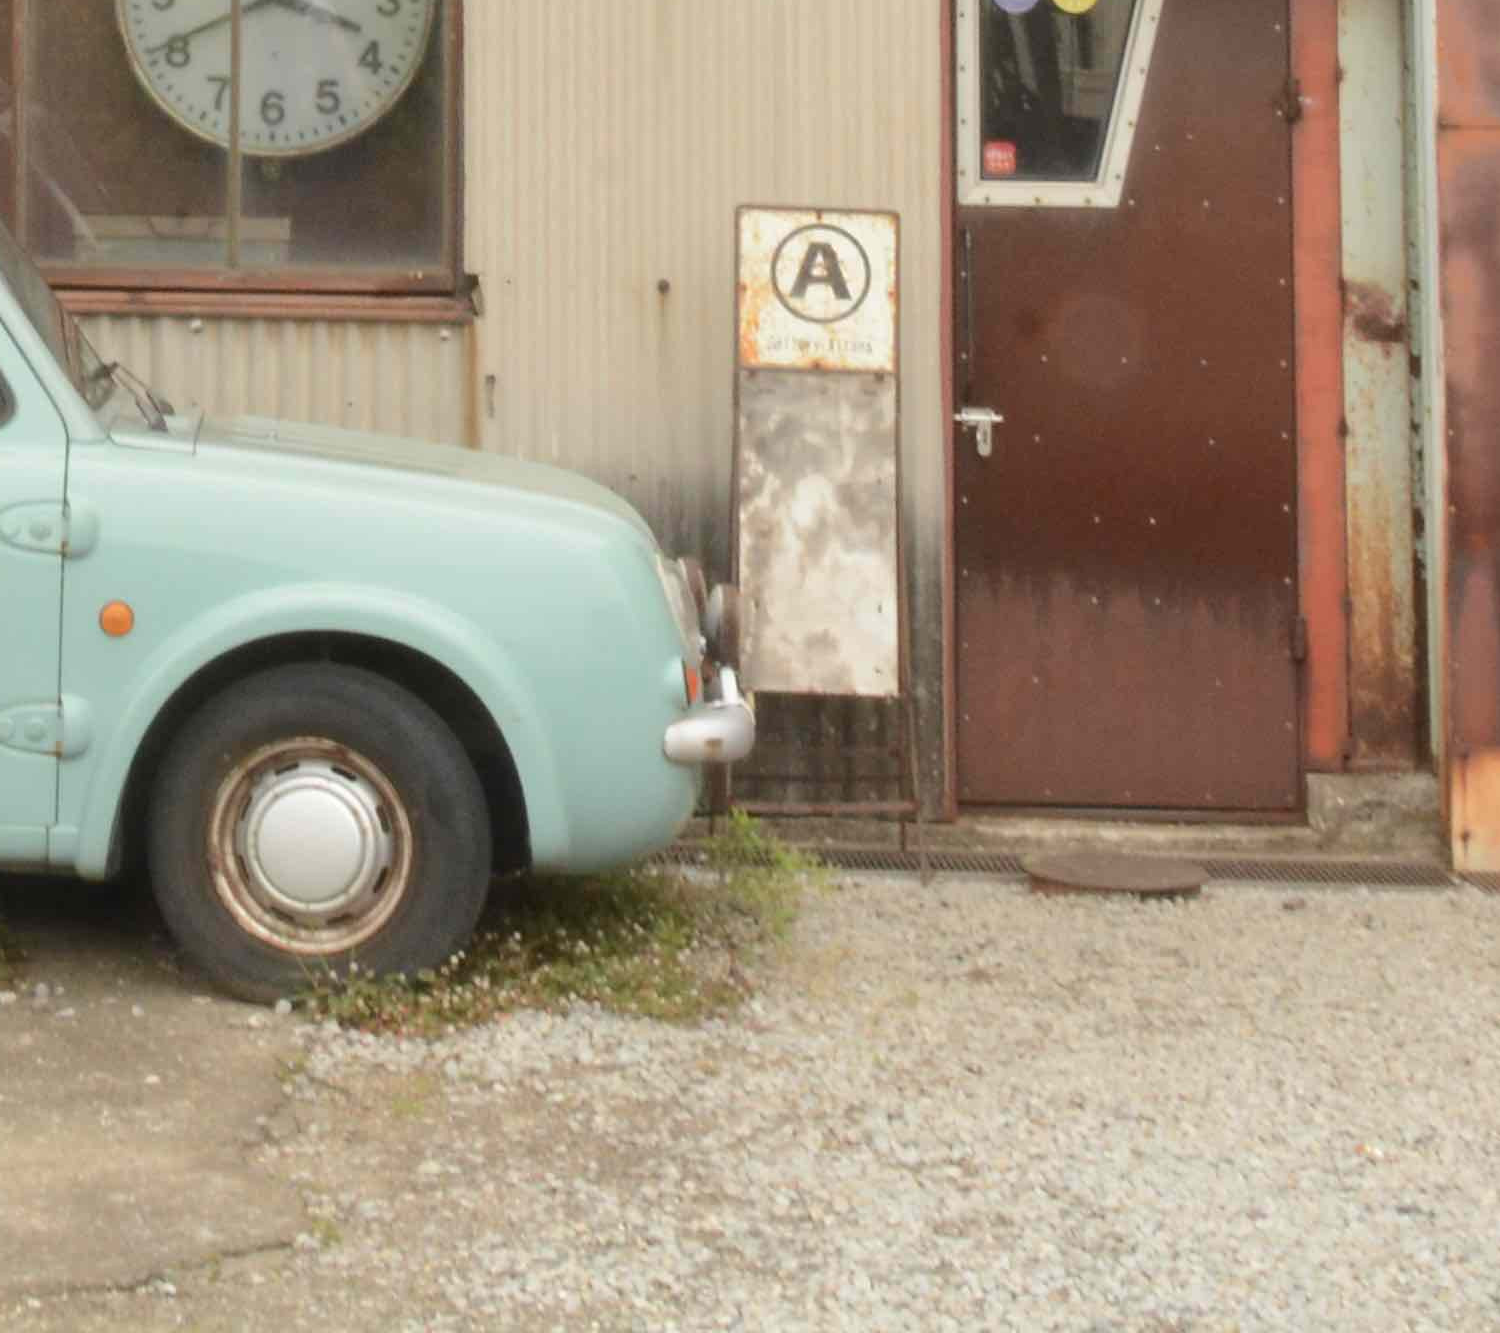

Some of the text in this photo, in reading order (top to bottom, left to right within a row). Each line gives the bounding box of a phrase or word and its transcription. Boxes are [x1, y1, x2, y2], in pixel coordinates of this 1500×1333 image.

[165, 34, 191, 69] 8
[356, 39, 383, 75] 4
[205, 74, 232, 112] 7
[259, 91, 286, 127] 6
[315, 79, 341, 115] 5
[790, 242, 853, 300] A
